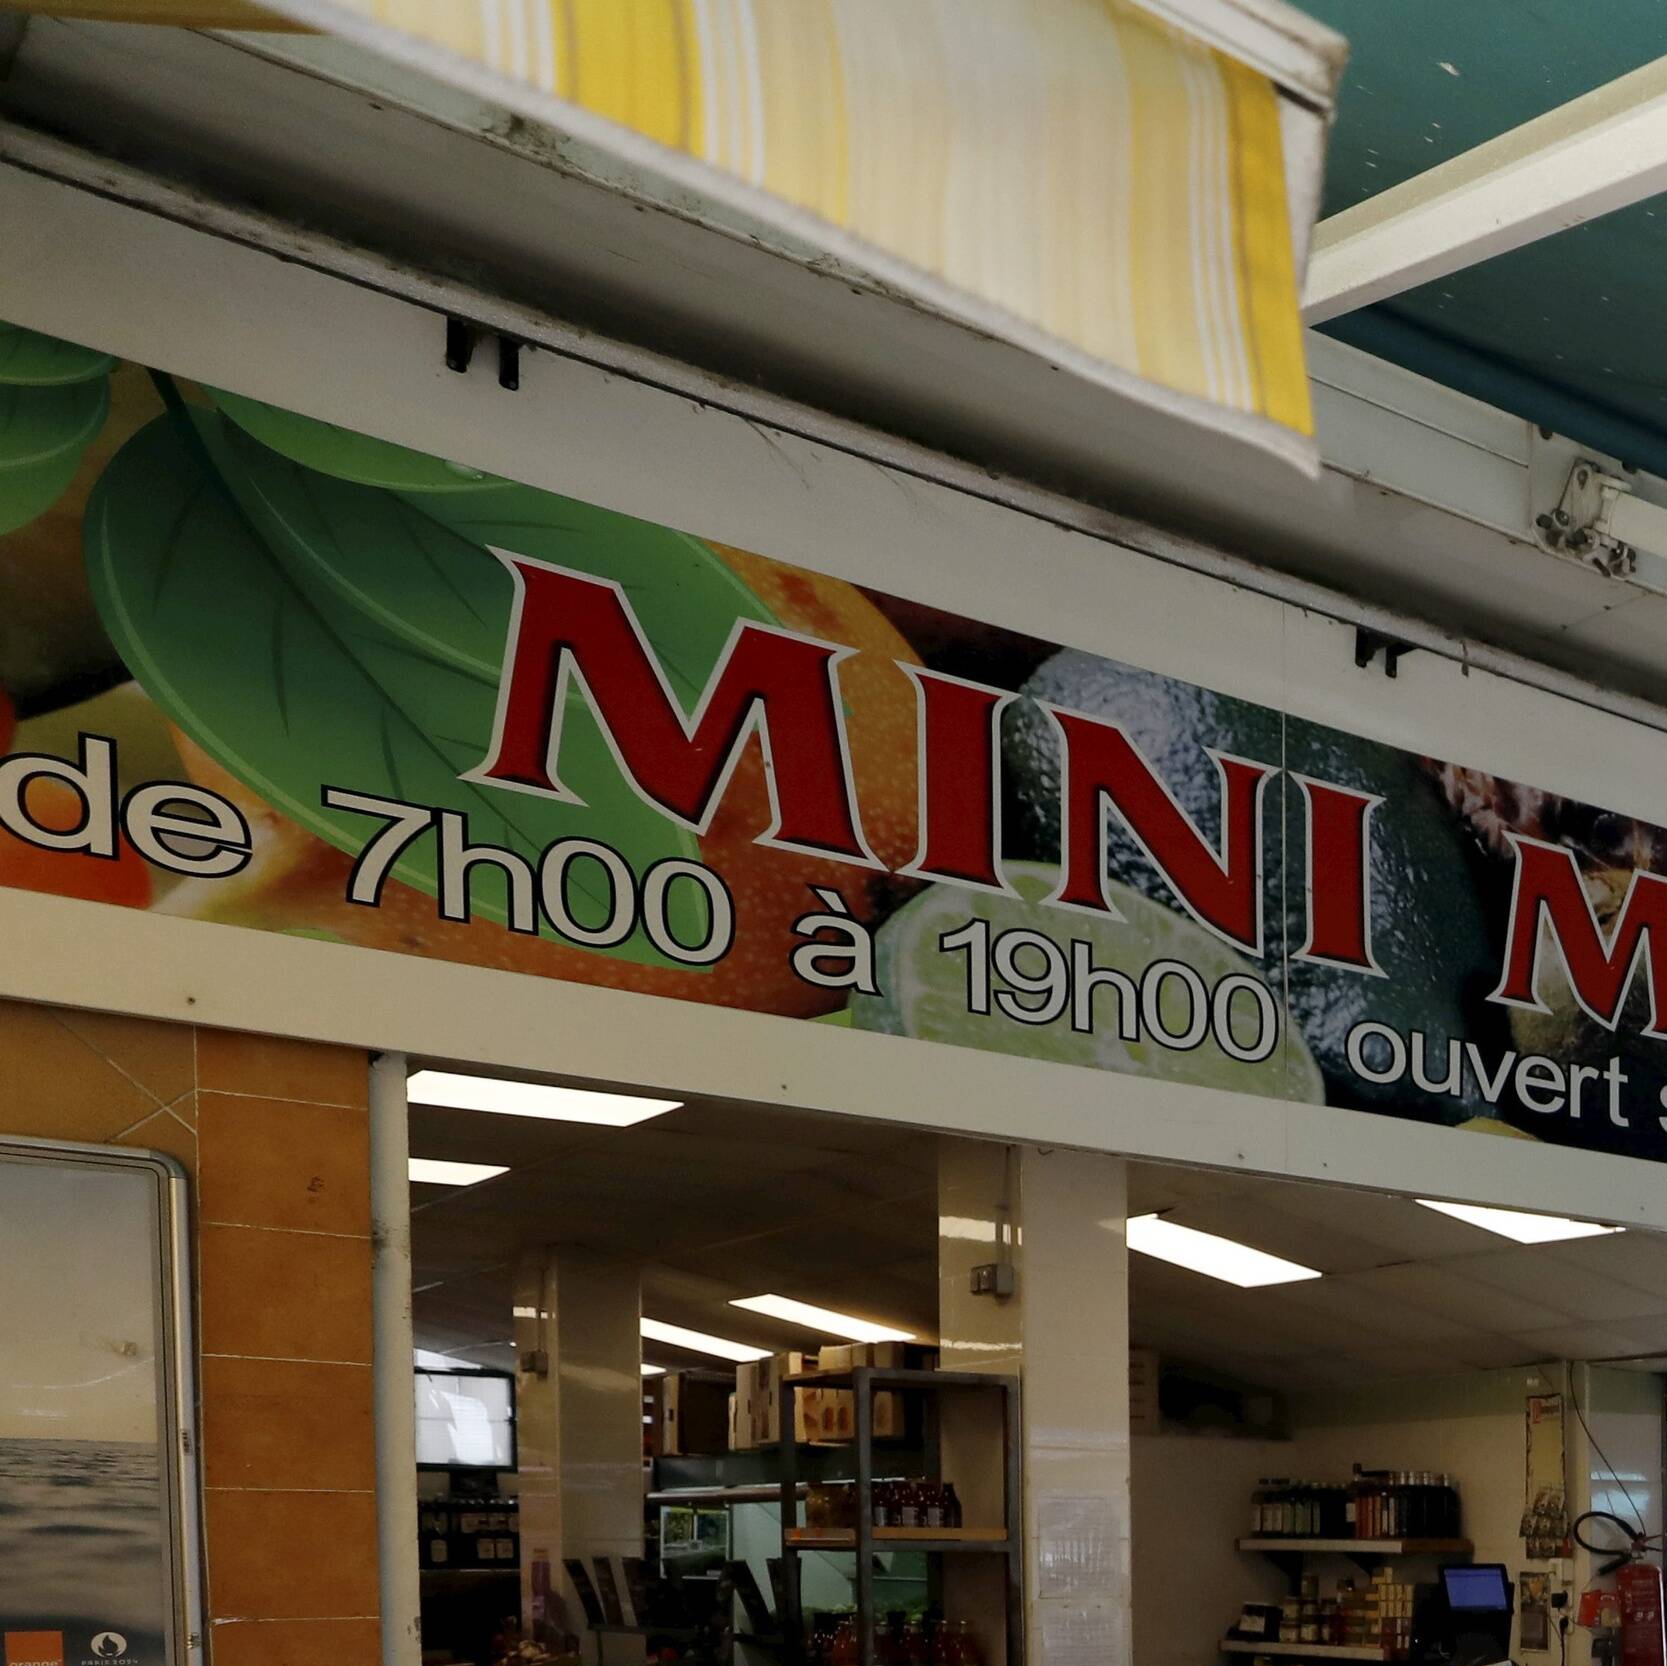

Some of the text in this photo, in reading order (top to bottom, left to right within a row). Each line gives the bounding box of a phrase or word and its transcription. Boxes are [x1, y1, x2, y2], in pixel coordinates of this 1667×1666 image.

[0, 730, 252, 878] de
[321, 784, 736, 966] 7h00
[790, 882, 883, 998] à
[938, 915, 1279, 1064] 19h00
[1344, 1020, 1631, 1129] ouvert
[458, 544, 1388, 978] MINI
